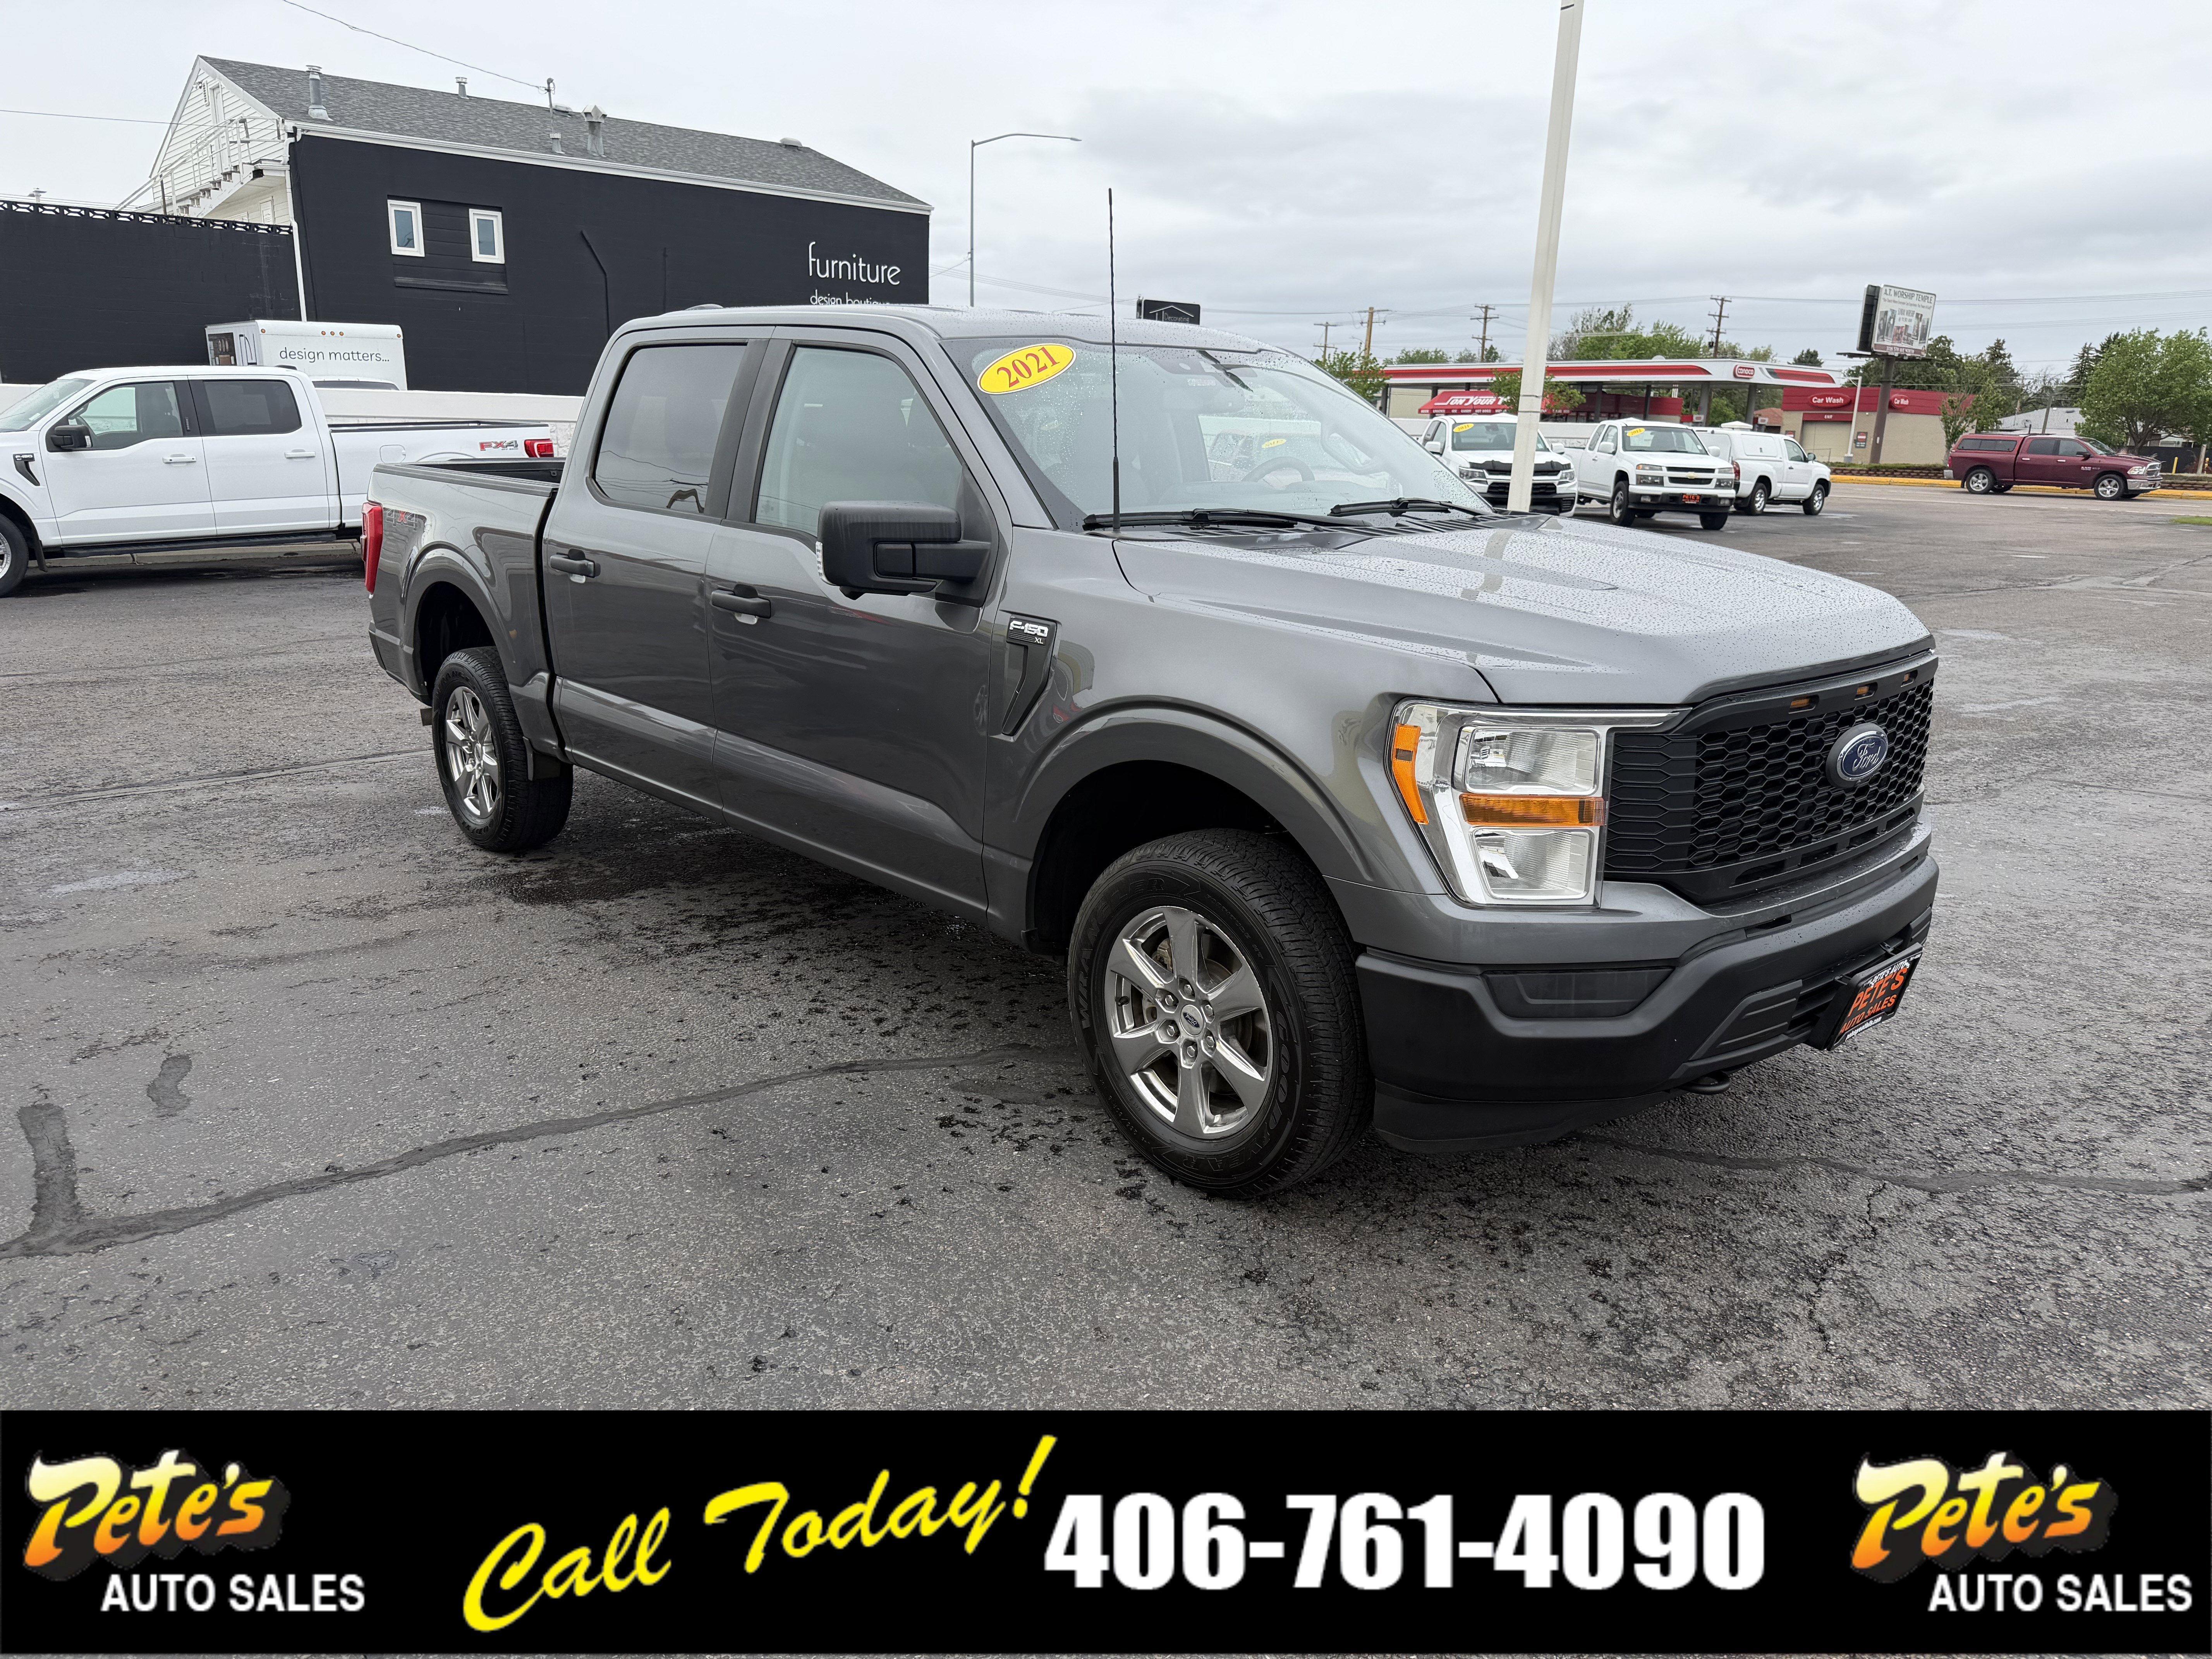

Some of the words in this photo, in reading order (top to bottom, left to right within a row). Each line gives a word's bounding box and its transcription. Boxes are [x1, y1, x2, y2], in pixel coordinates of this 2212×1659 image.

[809, 242, 901, 285] furniture
[810, 289, 842, 305] design
[1894, 290, 1915, 300] WORSHIP
[1916, 294, 1933, 304] TEMPLE
[279, 347, 325, 363] design
[329, 351, 390, 362] matters...
[997, 347, 1060, 388] 2021
[1464, 396, 1496, 405] YOUR
[479, 440, 518, 451] FX4
[1009, 620, 1049, 637] F-150
[1852, 742, 1881, 771] Ford
[1847, 967, 1908, 1017] PETE'S
[1839, 1012, 1865, 1034] AUTO
[1865, 994, 1897, 1019] SALES
[1183, 1012, 1290, 1171] GOODYEAR
